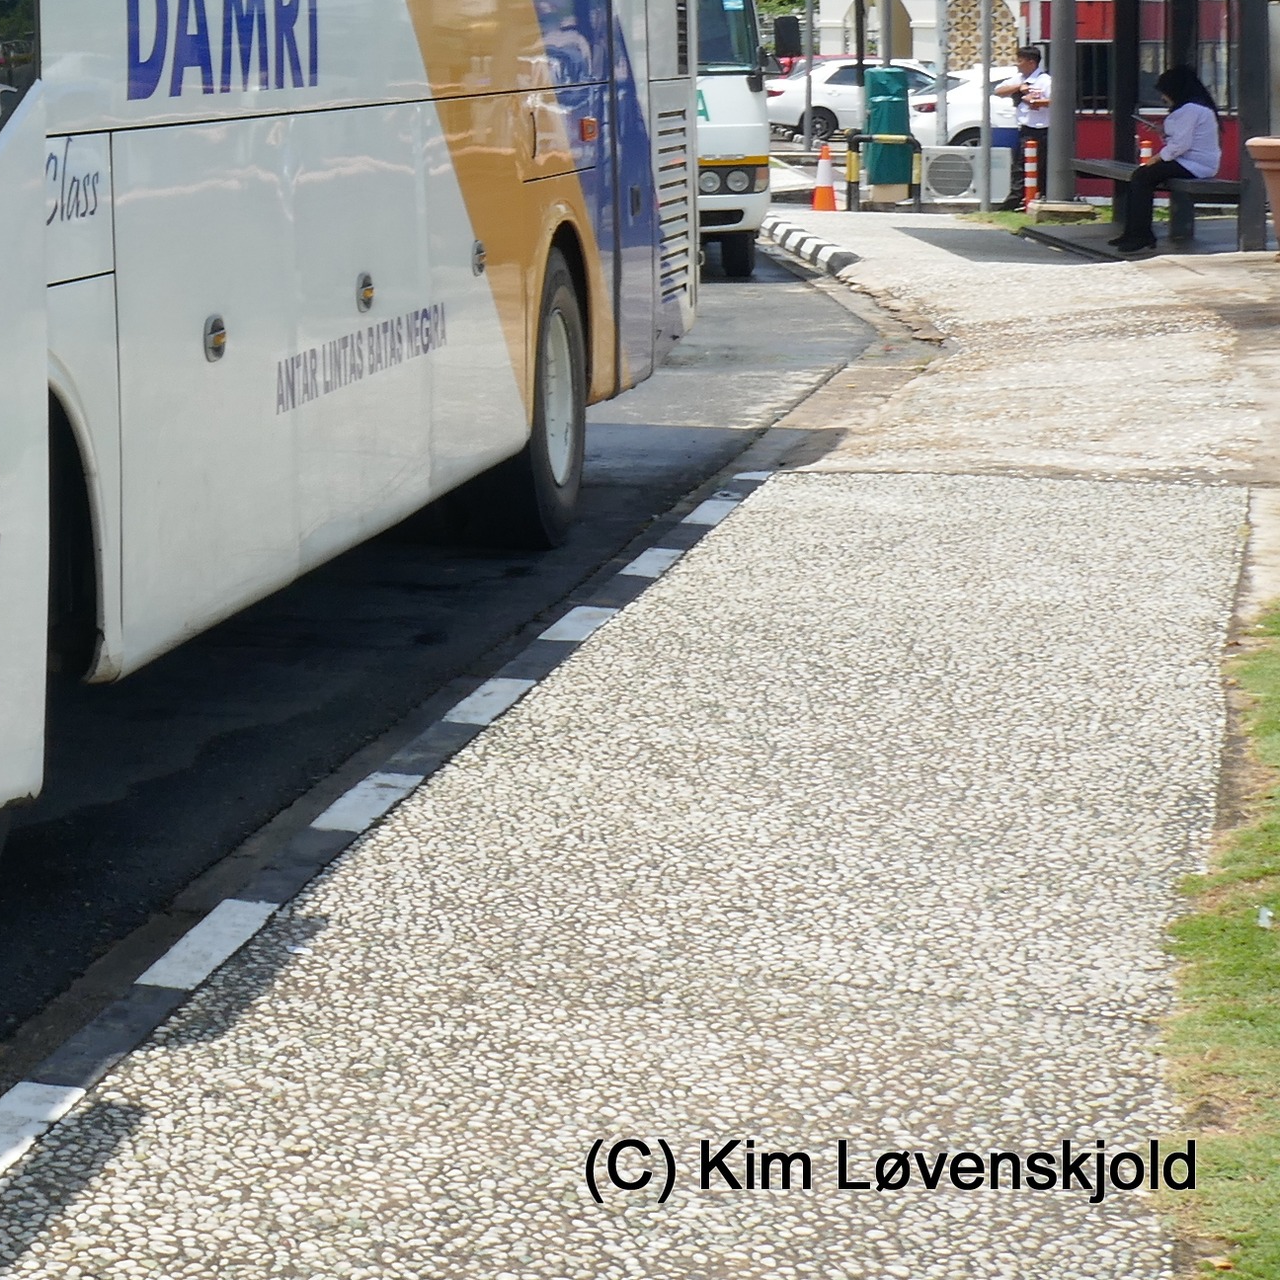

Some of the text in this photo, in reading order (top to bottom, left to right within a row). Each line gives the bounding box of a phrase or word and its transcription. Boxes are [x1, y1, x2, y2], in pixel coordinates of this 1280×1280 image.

[276, 348, 318, 415] ANTAR
[322, 330, 364, 395] LINTAS
[367, 317, 403, 375] BATAS
